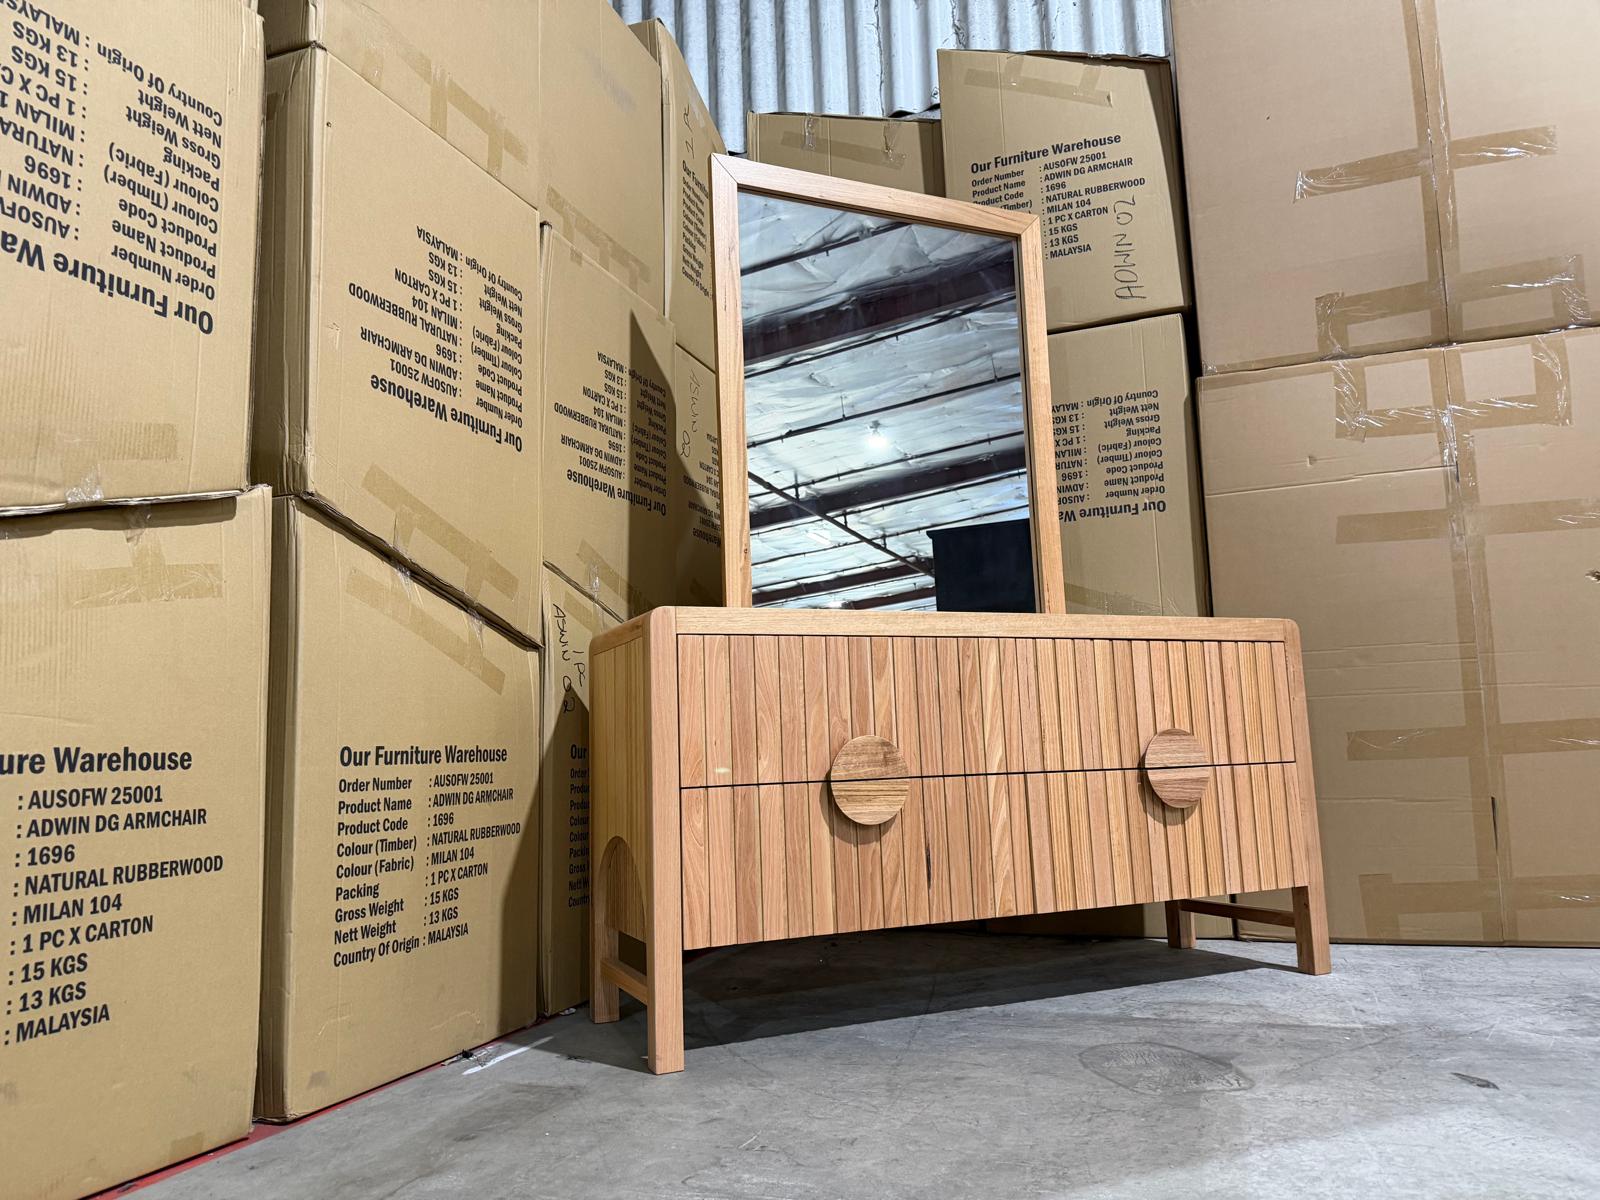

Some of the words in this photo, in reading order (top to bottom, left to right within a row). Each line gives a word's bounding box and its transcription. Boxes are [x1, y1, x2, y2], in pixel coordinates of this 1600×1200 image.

[13, 20, 52, 55] KGS
[12, 46, 50, 79] KGS
[56, 45, 78, 67] 13
[97, 42, 145, 82] Origin
[55, 70, 77, 92] 15
[148, 76, 164, 93] Of
[138, 89, 188, 132] Weight
[168, 83, 223, 126] Country
[15, 102, 75, 141] MILAN
[125, 106, 178, 148] Weight
[192, 125, 222, 148] Nett
[109, 142, 170, 188] (Fabric)
[163, 146, 219, 190] Packing
[182, 139, 220, 169] Gross
[971, 161, 992, 174] Our
[994, 148, 1049, 169] Furniture
[1051, 134, 1121, 155] Warehouse
[24, 155, 71, 189] 1696
[972, 178, 992, 187] Order
[994, 169, 1024, 182] Number
[1043, 158, 1078, 171] AUSOFW
[1080, 151, 1106, 163] 25001
[972, 187, 1002, 198] Product
[1004, 179, 1026, 190] Name
[1044, 169, 1072, 182] ADWIN
[1073, 165, 1086, 175] DG
[1087, 157, 1133, 173] ARMCHAIR
[8, 173, 72, 214] ADWIN
[104, 165, 169, 210] (Timber)
[173, 181, 219, 213] Colour
[1004, 191, 1024, 201] Code
[1046, 182, 1067, 192] 1696
[1046, 189, 1083, 203] NATURAL
[1085, 177, 1146, 195] RUBBERWOOD
[119, 199, 157, 228] Code
[172, 203, 218, 234] Colour
[1047, 203, 1073, 214] MILAN
[1075, 199, 1091, 208] 104
[1048, 217, 1052, 225] 1
[1055, 214, 1066, 223] PC
[1068, 212, 1073, 221] X
[1074, 206, 1108, 220] CARTON
[112, 220, 156, 250] Name
[161, 223, 217, 257] Product
[417, 226, 459, 260] MALAYSIA
[1049, 227, 1059, 236] 15
[1061, 223, 1078, 233] KGS
[1050, 239, 1059, 247] 13
[1061, 234, 1079, 244] KGS
[111, 245, 172, 283] Number
[160, 250, 216, 279] Product
[1050, 244, 1092, 258] MALAYSIA
[53, 253, 168, 318] Furniture
[175, 275, 215, 300] Order
[394, 268, 430, 298] CARTON
[174, 301, 213, 335] Our
[349, 283, 417, 326] RUBBERWOOD
[412, 296, 428, 314] 104
[431, 308, 458, 330] MILAN
[360, 326, 412, 358] ARMCHAIR
[420, 319, 458, 347] NATURAL
[415, 353, 426, 365] DG
[436, 344, 457, 363] 1696
[597, 351, 625, 373] MALAYSIA
[389, 358, 419, 380] 25001
[430, 361, 458, 380] ADWIN
[371, 374, 448, 422] Warehouse
[421, 372, 458, 398] AUSOFW
[582, 385, 606, 404] CARTON
[1125, 390, 1158, 402] Country
[554, 402, 598, 430] RUBBERWOOD
[1087, 397, 1111, 407] Origin
[450, 407, 501, 444] Furniture
[1126, 426, 1160, 437] Packing
[504, 436, 522, 452] Our
[560, 434, 593, 456] ARMCHAIR
[566, 468, 615, 499] Warehouse
[1062, 471, 1083, 481] 1696
[1104, 478, 1128, 486] Name
[1132, 473, 1164, 484] Product
[1141, 485, 1165, 494] Order
[1105, 489, 1139, 498] Number
[1142, 500, 1166, 512] Our
[1080, 503, 1138, 518] Furniture
[54, 746, 192, 773] Warehouse
[340, 746, 370, 767] Our
[375, 746, 441, 766] Furniture
[445, 745, 507, 763] Warehouse
[339, 778, 370, 792] Order
[373, 777, 412, 791] Number
[433, 773, 469, 787] AUSOFW
[470, 772, 493, 785] 25001
[28, 788, 108, 810] AUSOFW
[111, 786, 163, 805] 25001
[338, 800, 381, 814] Product
[384, 797, 412, 811] Name
[433, 792, 461, 807] ADWIN
[463, 792, 474, 804] DG
[475, 788, 513, 803] ARMCHAIR
[26, 816, 90, 838] ADWIN
[95, 814, 119, 832] DG
[123, 808, 207, 830] ARMCHAIR
[338, 821, 380, 836] Product
[383, 817, 408, 831] Code
[433, 812, 454, 826] 1696
[337, 841, 373, 857] Colour
[375, 836, 416, 855] (Timber)
[431, 828, 468, 846] NATURAL
[470, 823, 520, 840] RUBBERWOOD
[27, 844, 76, 866] 1696
[336, 862, 372, 879] Colour
[375, 856, 414, 876] (Fabric)
[431, 849, 458, 865] MILAN
[459, 847, 474, 861] 104
[24, 868, 108, 895] NATURAL
[113, 855, 223, 885] RUBBERWOOD
[336, 883, 379, 901] Packing
[431, 872, 436, 886] 1
[438, 870, 449, 884] PC
[450, 868, 456, 882] X
[458, 863, 488, 880] CARTON
[23, 898, 84, 924] MILAN
[90, 894, 122, 915] 104
[335, 907, 366, 923] Gross
[368, 898, 404, 918] Weight
[430, 892, 440, 905] 15
[442, 887, 459, 902] KGS
[22, 934, 33, 953] 1
[40, 929, 64, 950] PC
[69, 926, 81, 945] X
[85, 915, 154, 942] CARTON
[334, 927, 358, 944] Nett
[361, 920, 396, 940] Weight
[429, 911, 440, 924] 13
[441, 906, 458, 921] KGS
[334, 947, 376, 967] Country
[378, 942, 390, 957] Of
[392, 935, 420, 953] Origin
[428, 923, 468, 944] MALAYSIA
[21, 961, 45, 983] 15
[50, 952, 88, 978] KGS
[19, 990, 43, 1012] 13
[48, 981, 86, 1006] KGS
[16, 1004, 110, 1043] MALAYSIA
